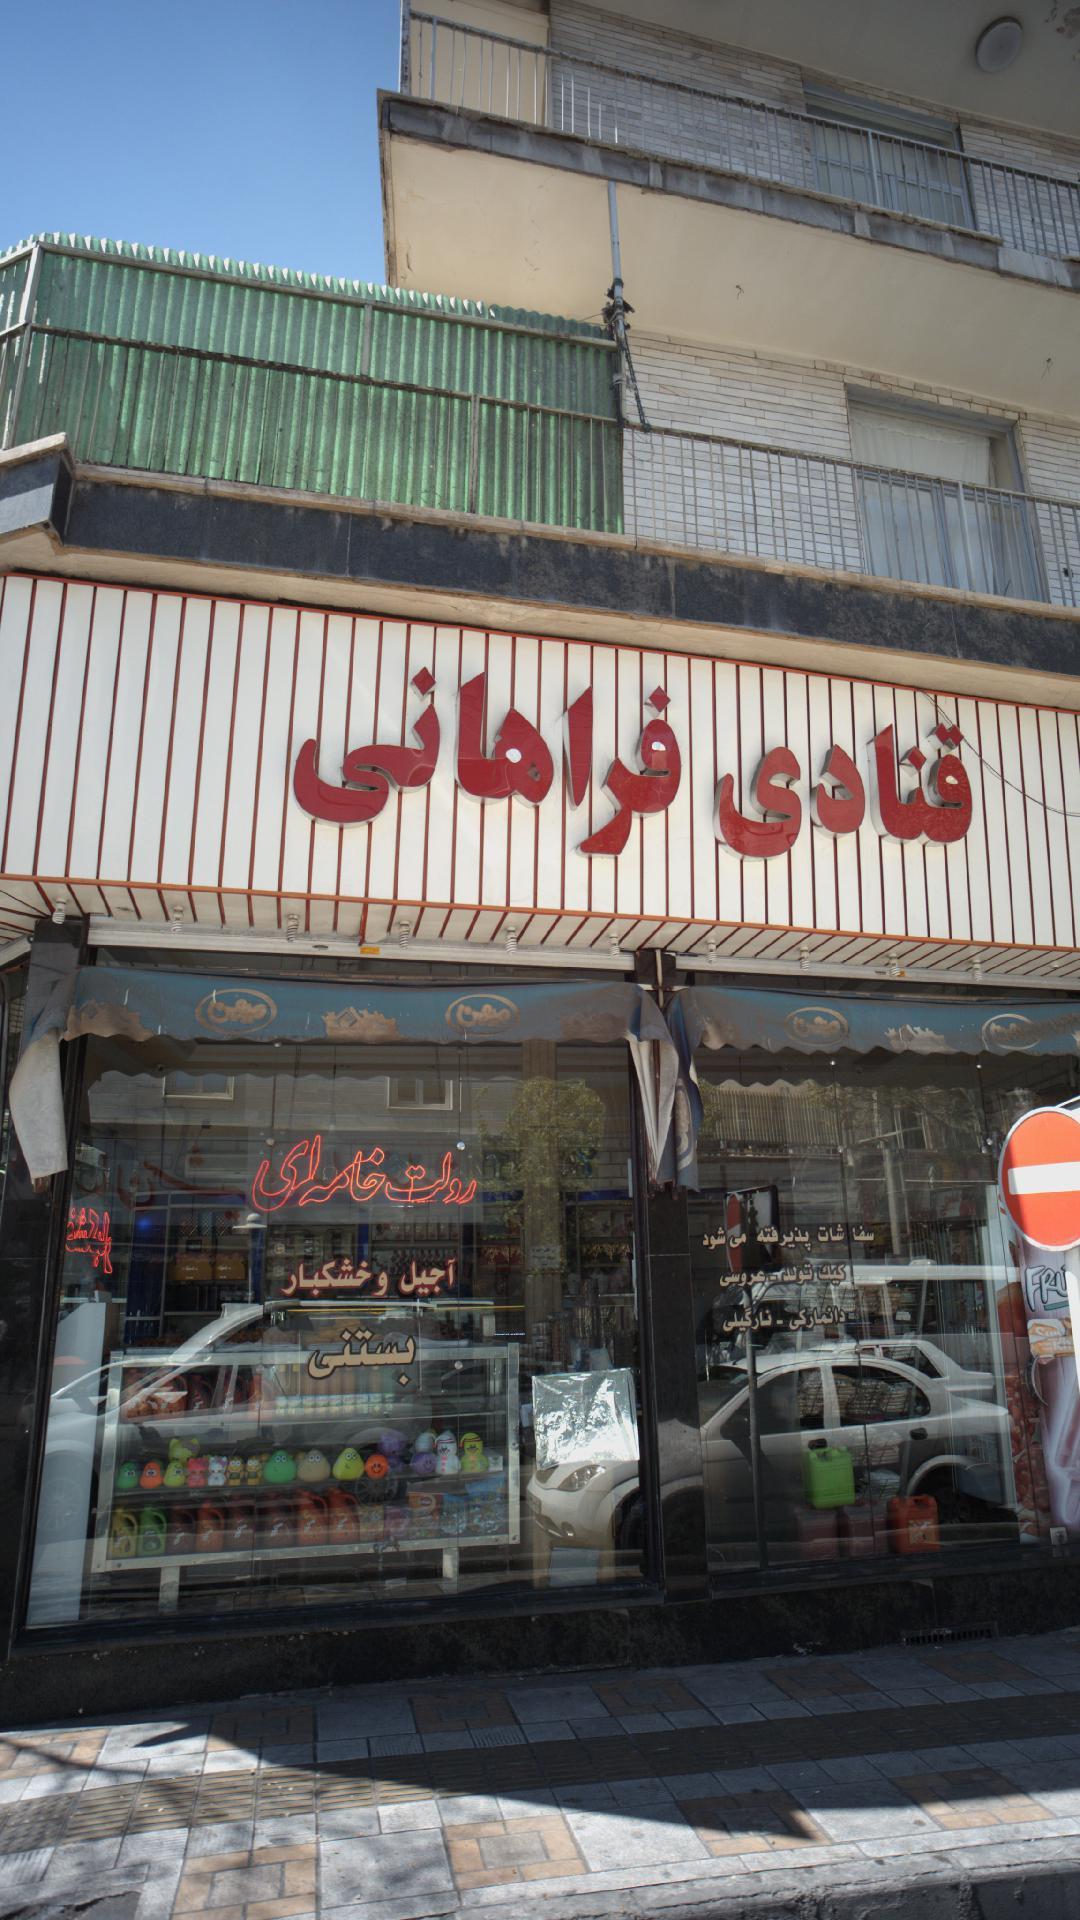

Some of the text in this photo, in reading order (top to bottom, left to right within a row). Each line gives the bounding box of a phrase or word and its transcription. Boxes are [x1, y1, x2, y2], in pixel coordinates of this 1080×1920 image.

[294, 666, 973, 860] قنادی فراهانی
[386, 1151, 478, 1205] رولت
[756, 1225, 812, 1251] پذیرفته
[280, 1256, 372, 1297] خشکبار
[398, 1256, 458, 1296] آجیل
[719, 1270, 767, 1288] عروسی
[783, 1263, 814, 1285] تولد
[722, 1306, 773, 1332] نارگیلی
[788, 1305, 846, 1331] دانمارکی
[308, 1328, 417, 1387] بستنی
